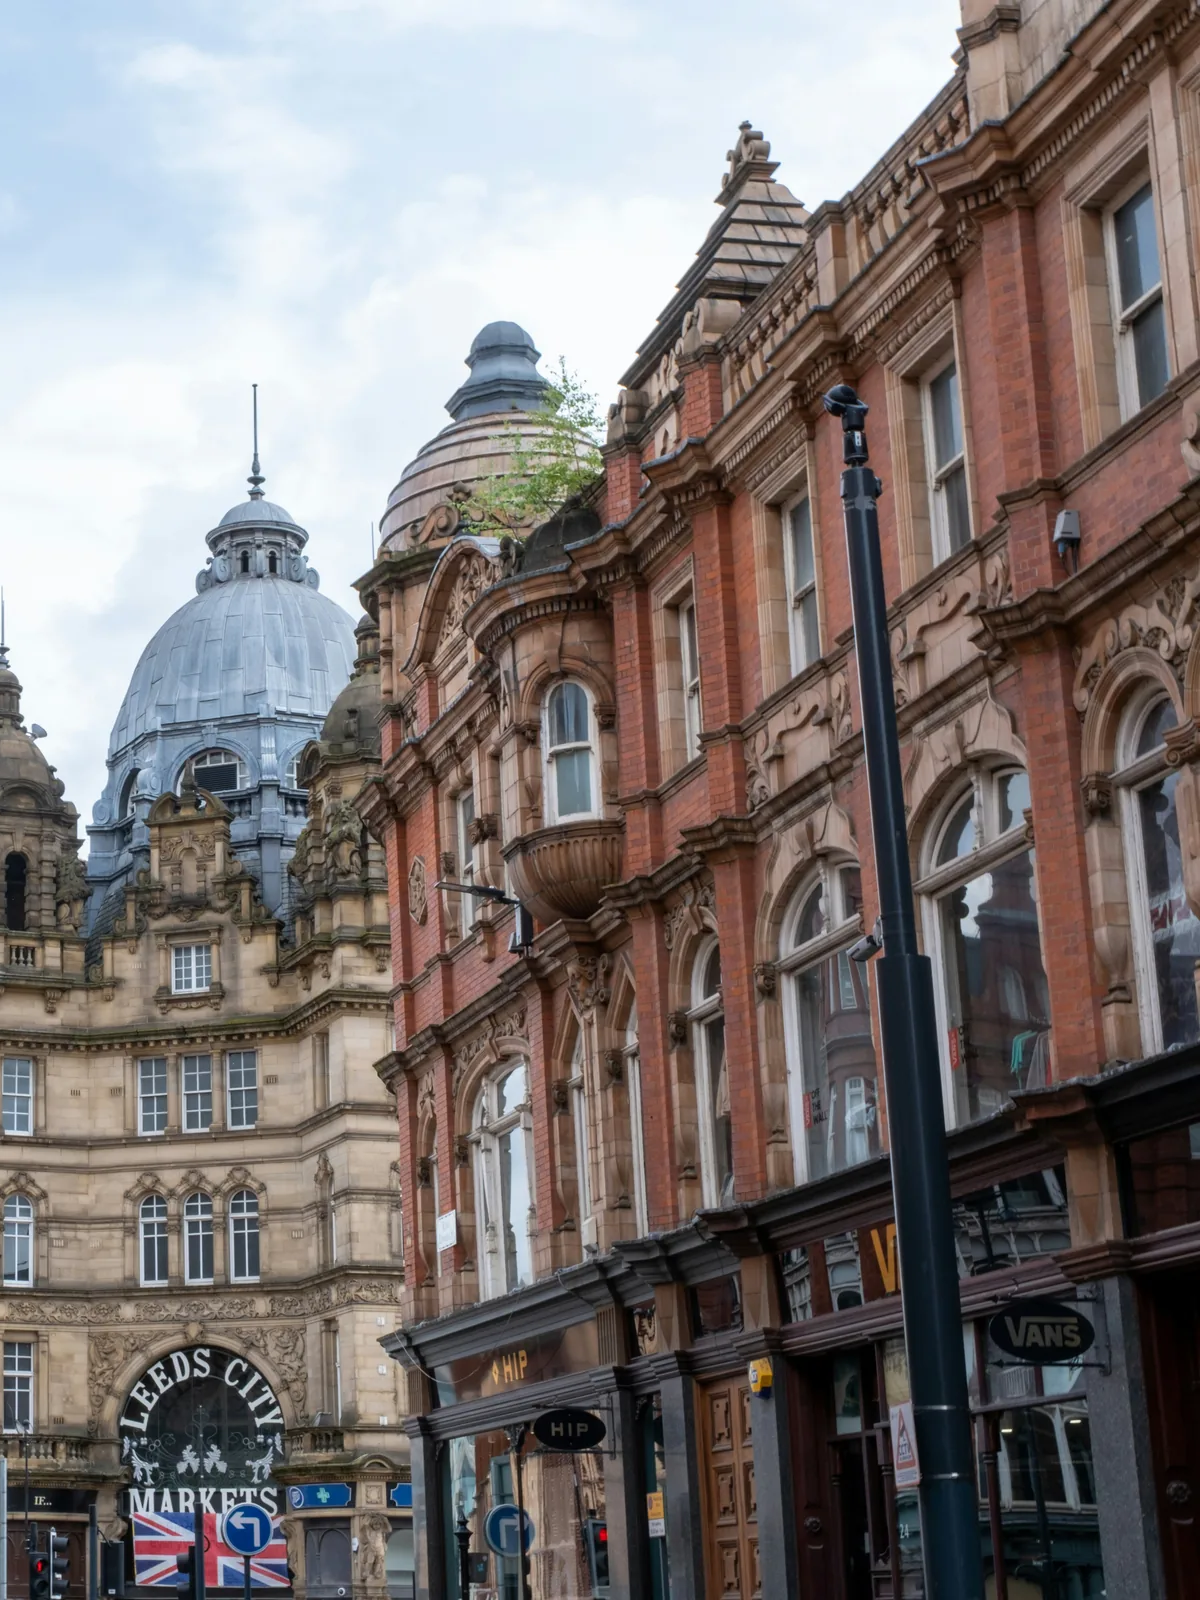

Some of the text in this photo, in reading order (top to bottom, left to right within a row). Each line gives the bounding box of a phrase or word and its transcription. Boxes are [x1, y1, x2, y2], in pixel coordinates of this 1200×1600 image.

[812, 1099, 821, 1112] THE
[1004, 1316, 1081, 1348] VANS
[502, 1349, 528, 1384] HIP
[120, 1347, 284, 1432] LEEDS CITY
[550, 1422, 589, 1437] HIP
[128, 1487, 279, 1518] MARKETS
[899, 1523, 910, 1539] 24
